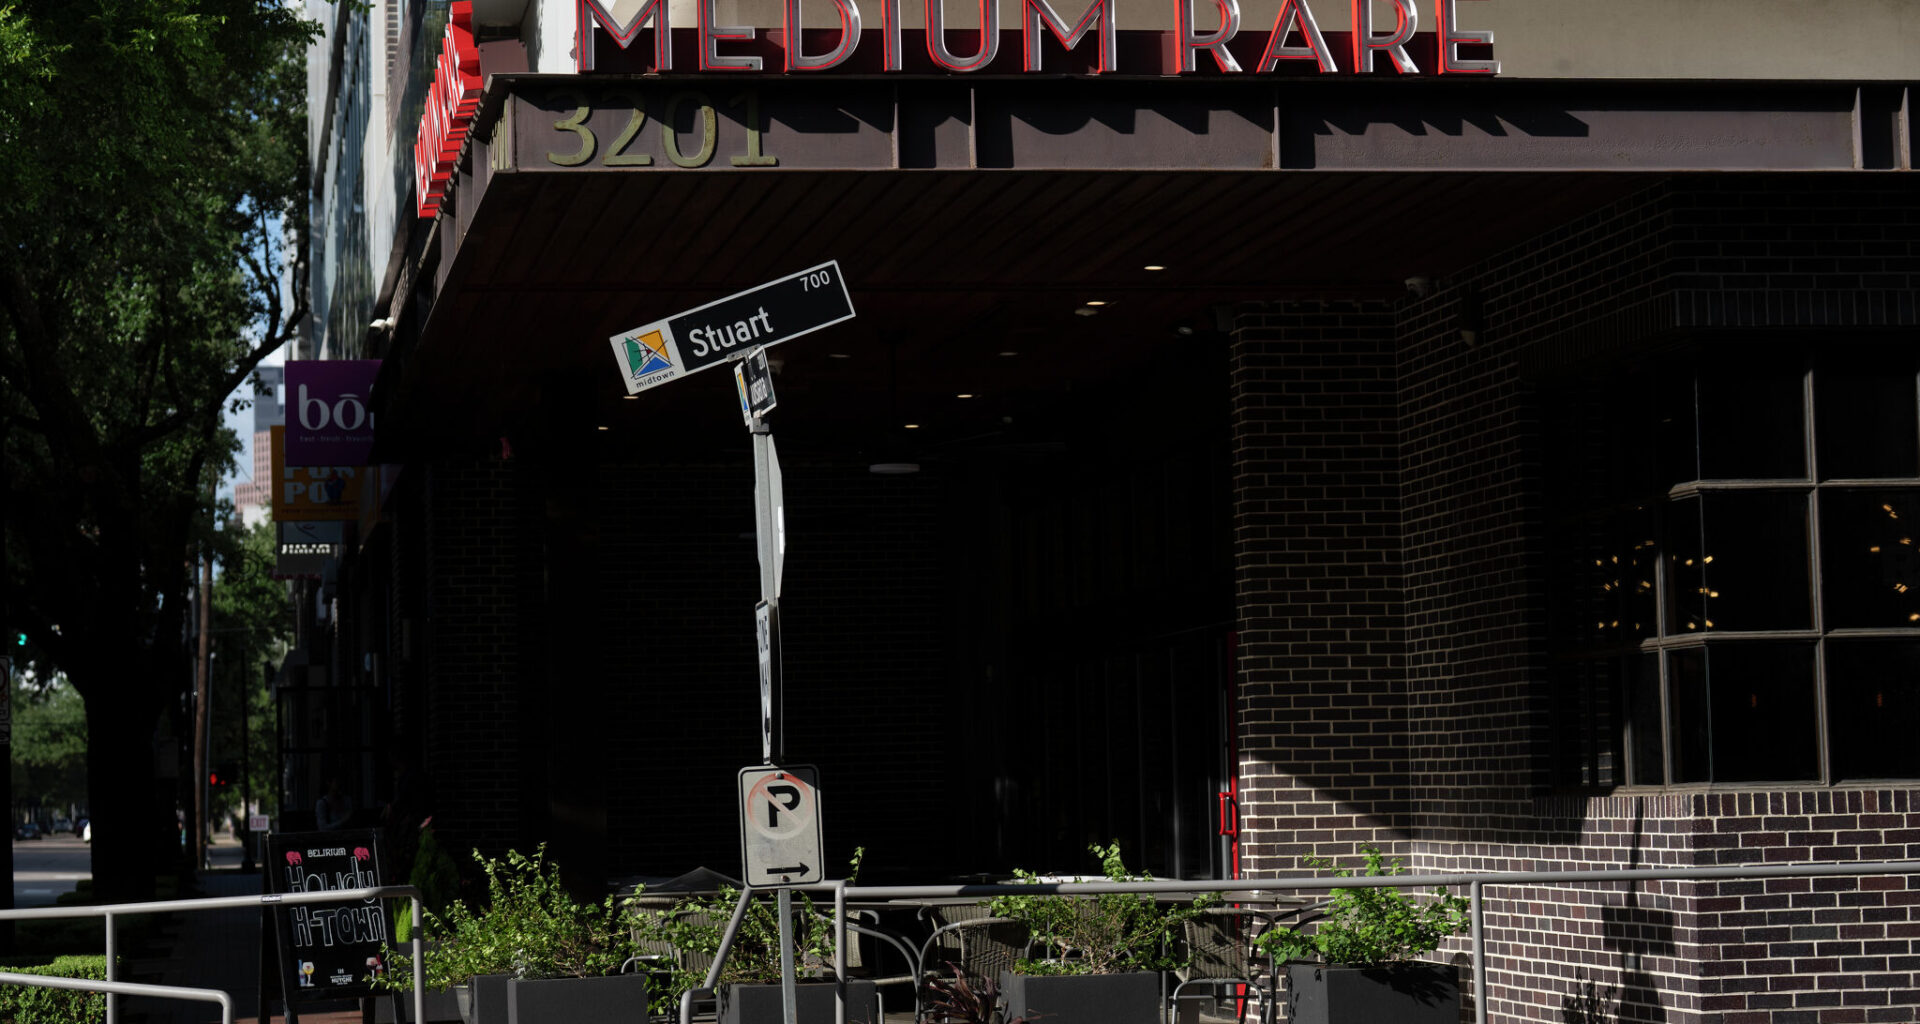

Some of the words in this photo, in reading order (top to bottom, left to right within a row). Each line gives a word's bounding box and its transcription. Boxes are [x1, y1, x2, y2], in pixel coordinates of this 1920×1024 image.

[576, 0, 1116, 72] MEDIUM
[1175, 0, 1500, 75] RARE
[547, 87, 778, 168] 3201
[800, 269, 831, 293] 700
[688, 306, 774, 357] Stuart
[636, 370, 675, 388] midtown
[307, 847, 346, 858] DELIRIUM
